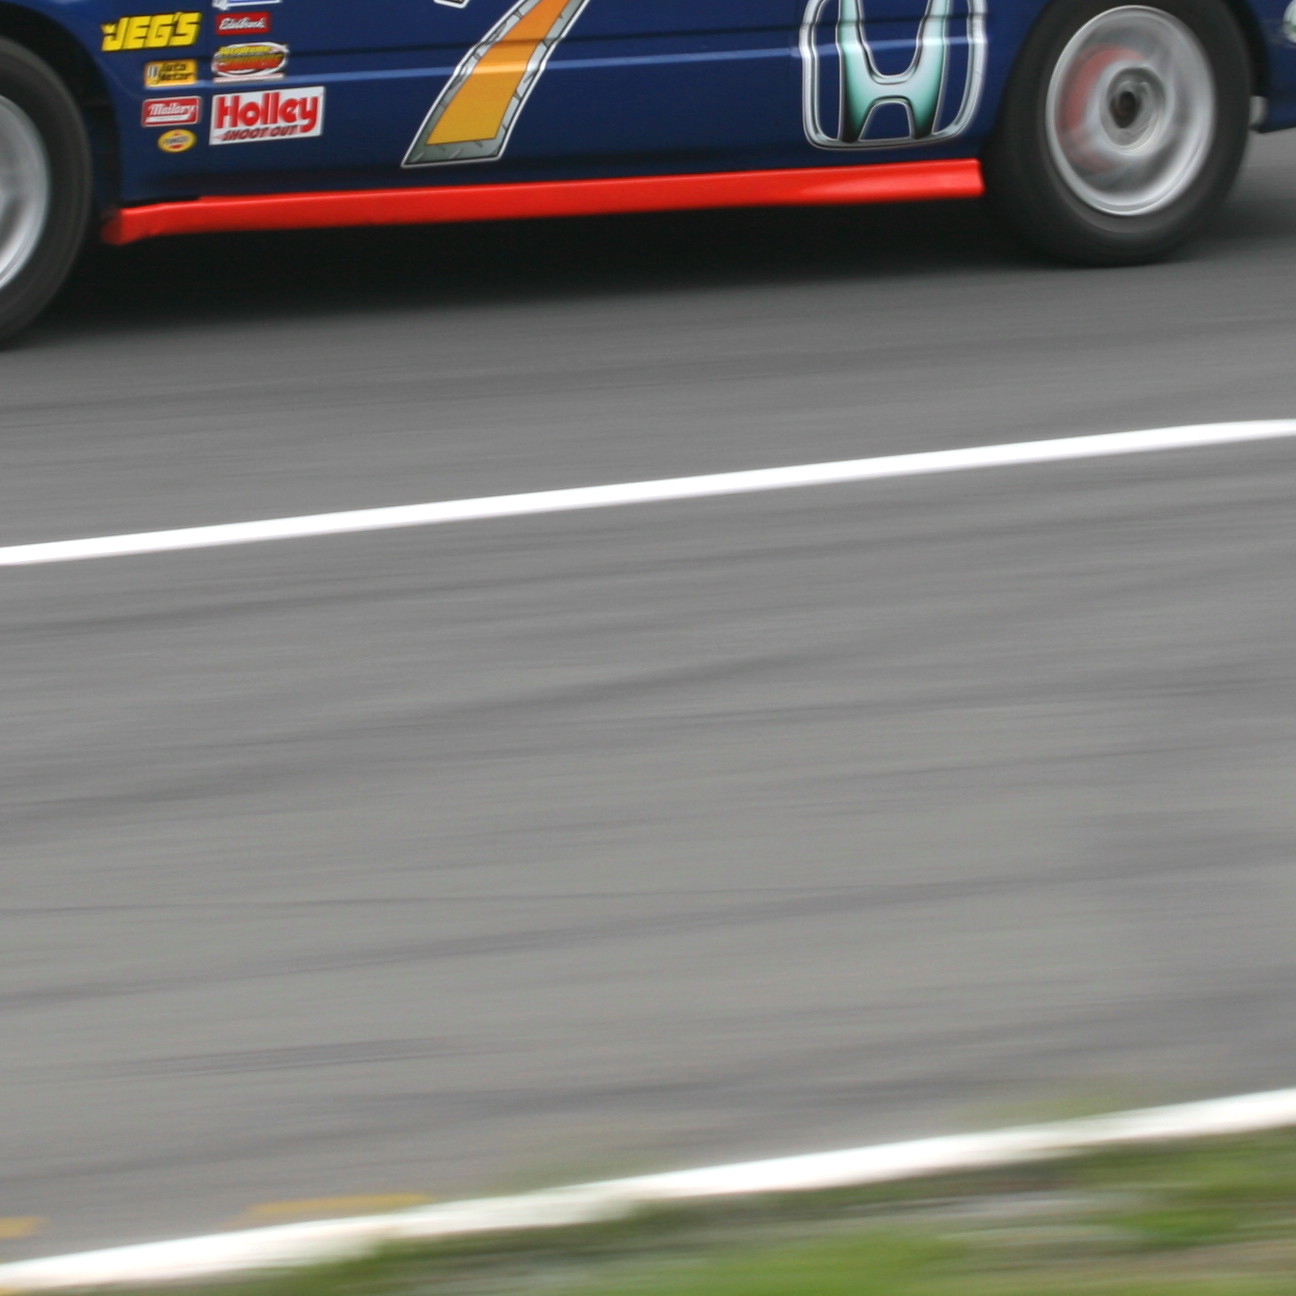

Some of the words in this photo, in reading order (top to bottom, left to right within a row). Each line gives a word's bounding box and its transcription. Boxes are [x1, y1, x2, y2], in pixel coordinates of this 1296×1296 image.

[101, 11, 202, 52] JEG'S
[215, 91, 320, 133] Holley
[222, 126, 270, 141] SHOOT
[270, 124, 300, 137] OUT
